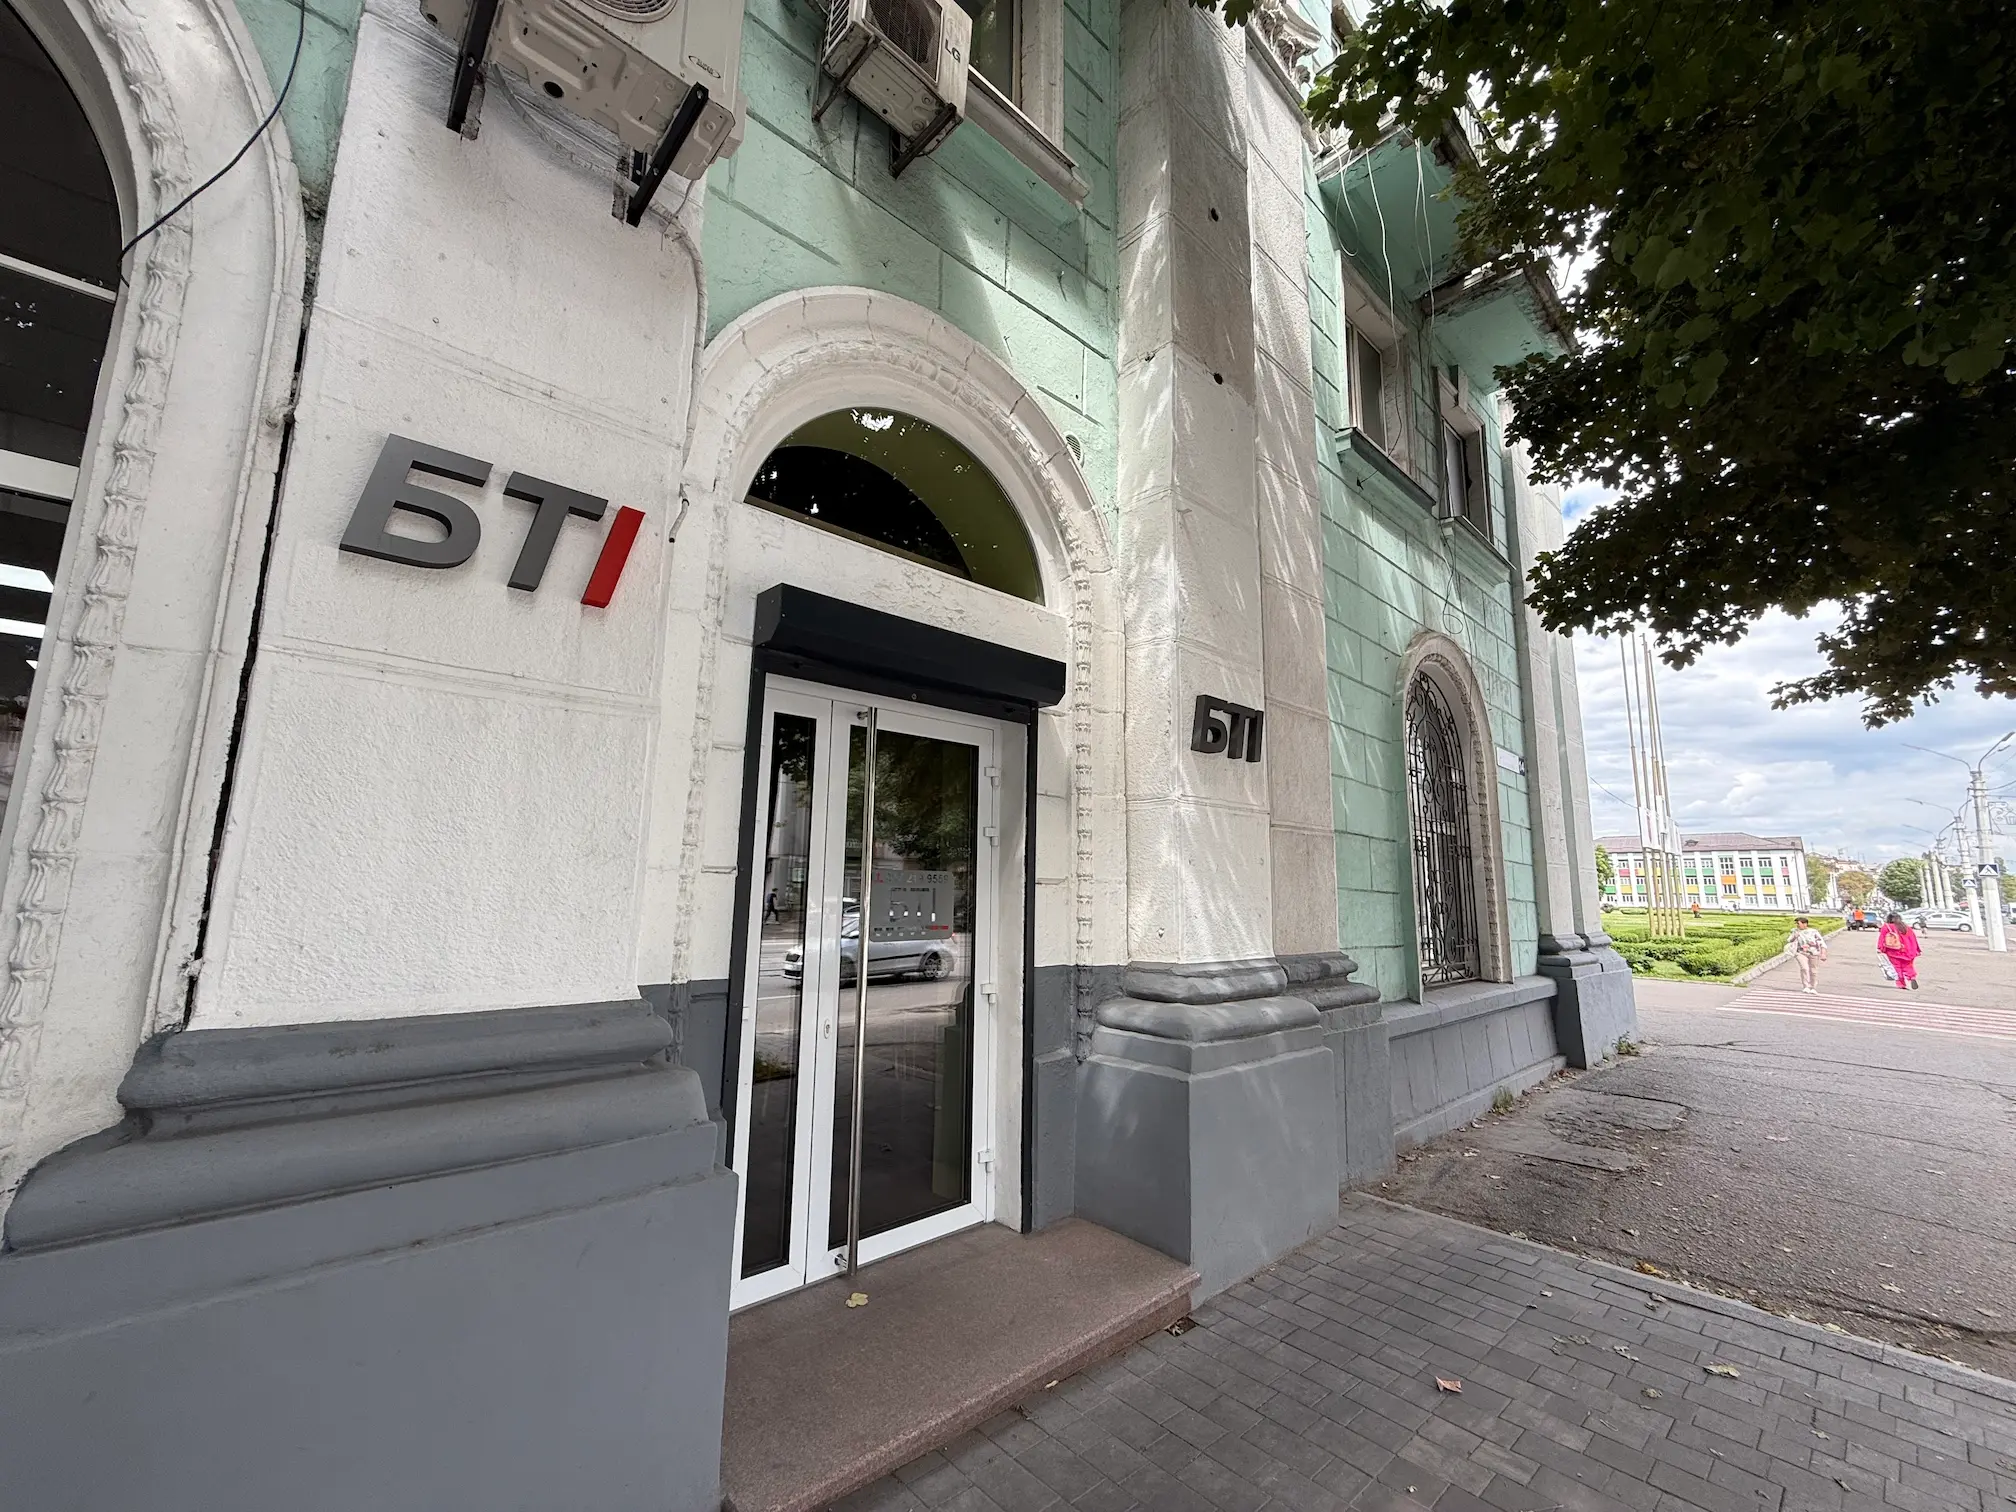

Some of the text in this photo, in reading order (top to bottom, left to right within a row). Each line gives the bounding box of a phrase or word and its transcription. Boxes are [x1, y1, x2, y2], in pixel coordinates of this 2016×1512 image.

[944, 38, 961, 64] LG
[339, 433, 646, 609] БТІ
[1191, 694, 1264, 763] БТІ
